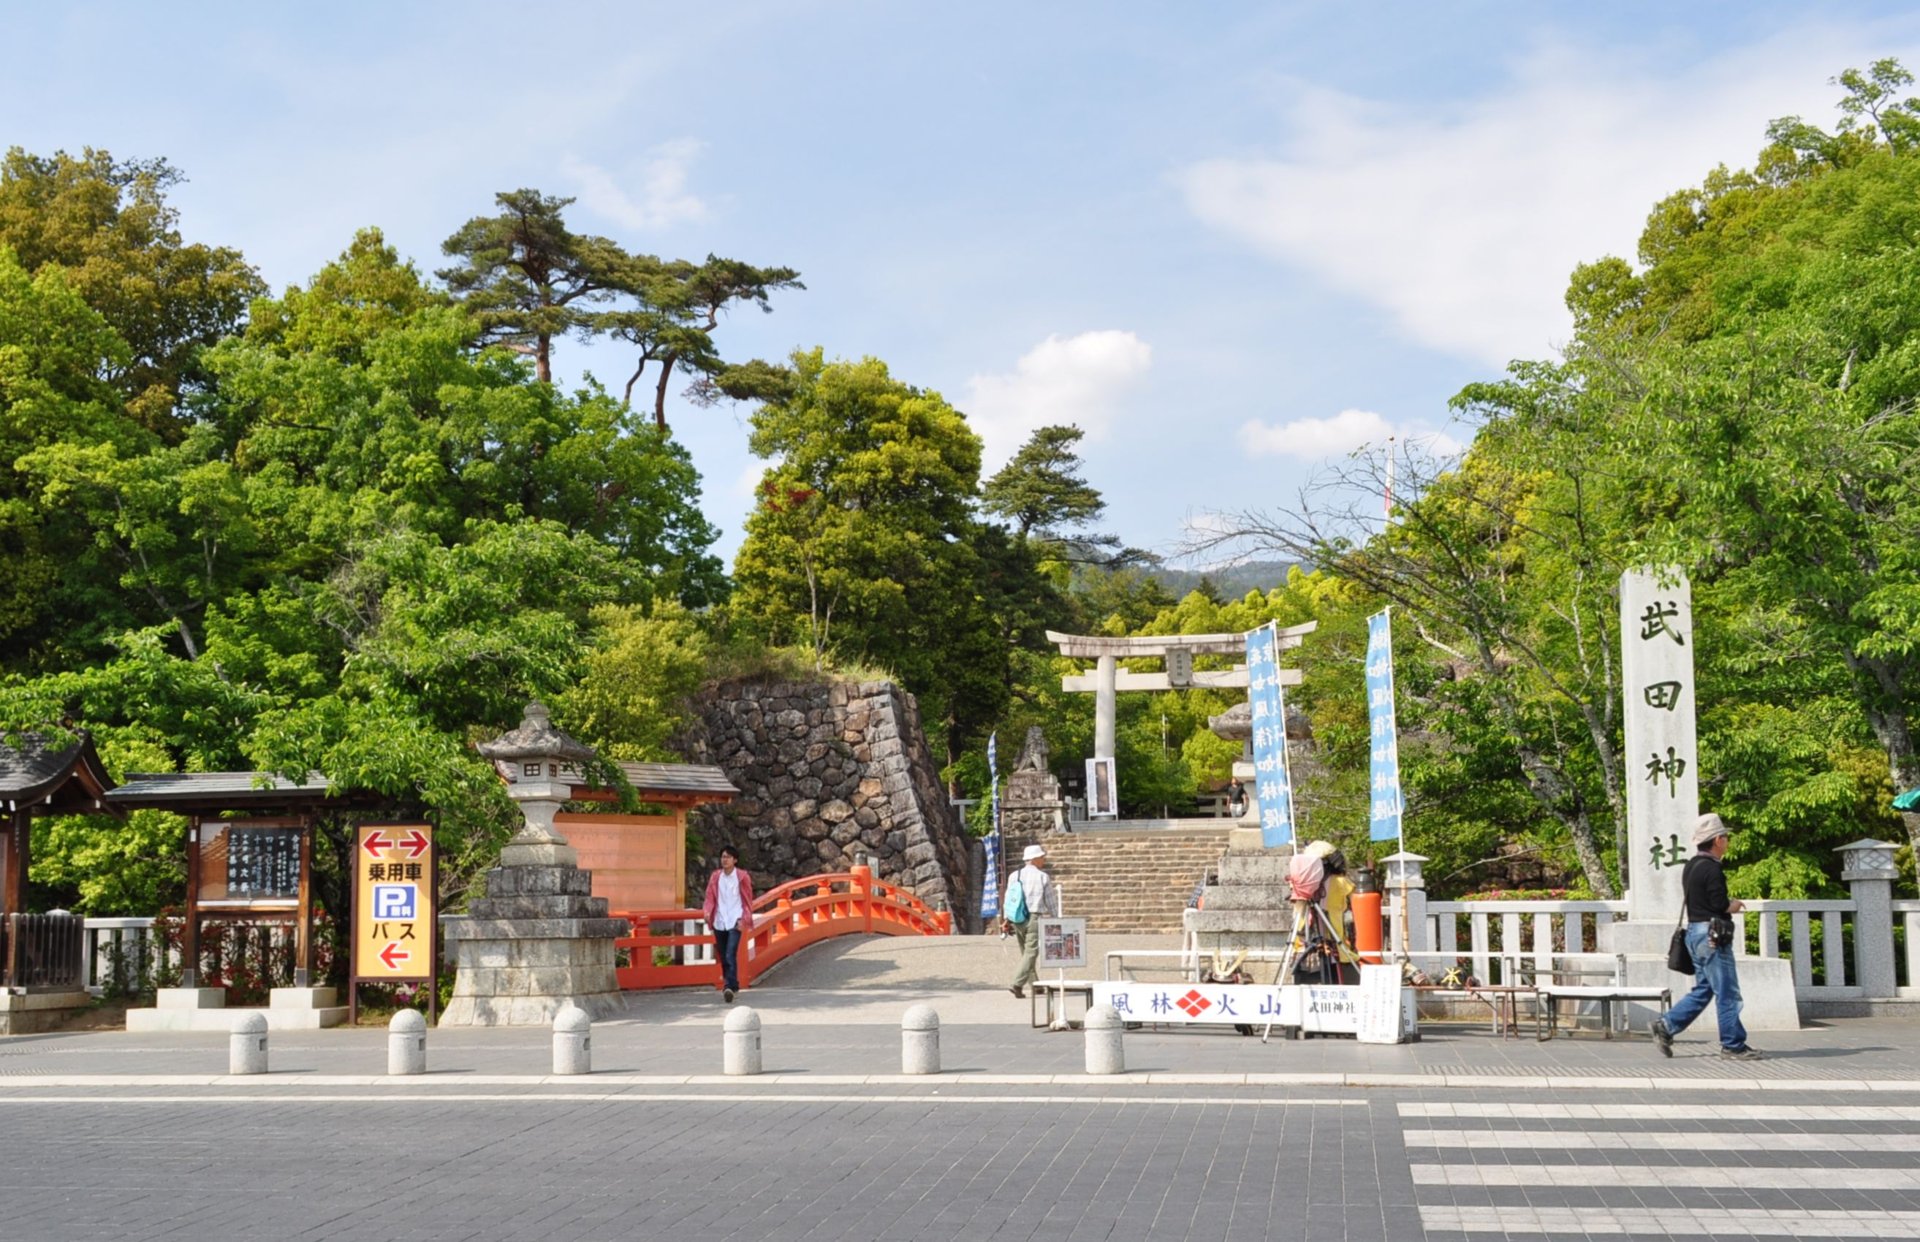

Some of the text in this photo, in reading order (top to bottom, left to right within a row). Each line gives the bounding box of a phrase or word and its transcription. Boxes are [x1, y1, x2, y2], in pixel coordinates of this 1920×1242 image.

[1640, 600, 1688, 870] 武田神社
[368, 863, 422, 881] 乗用車
[378, 888, 407, 917] P
[372, 923, 415, 940] バス
[1111, 992, 1282, 1016] 風林火山
